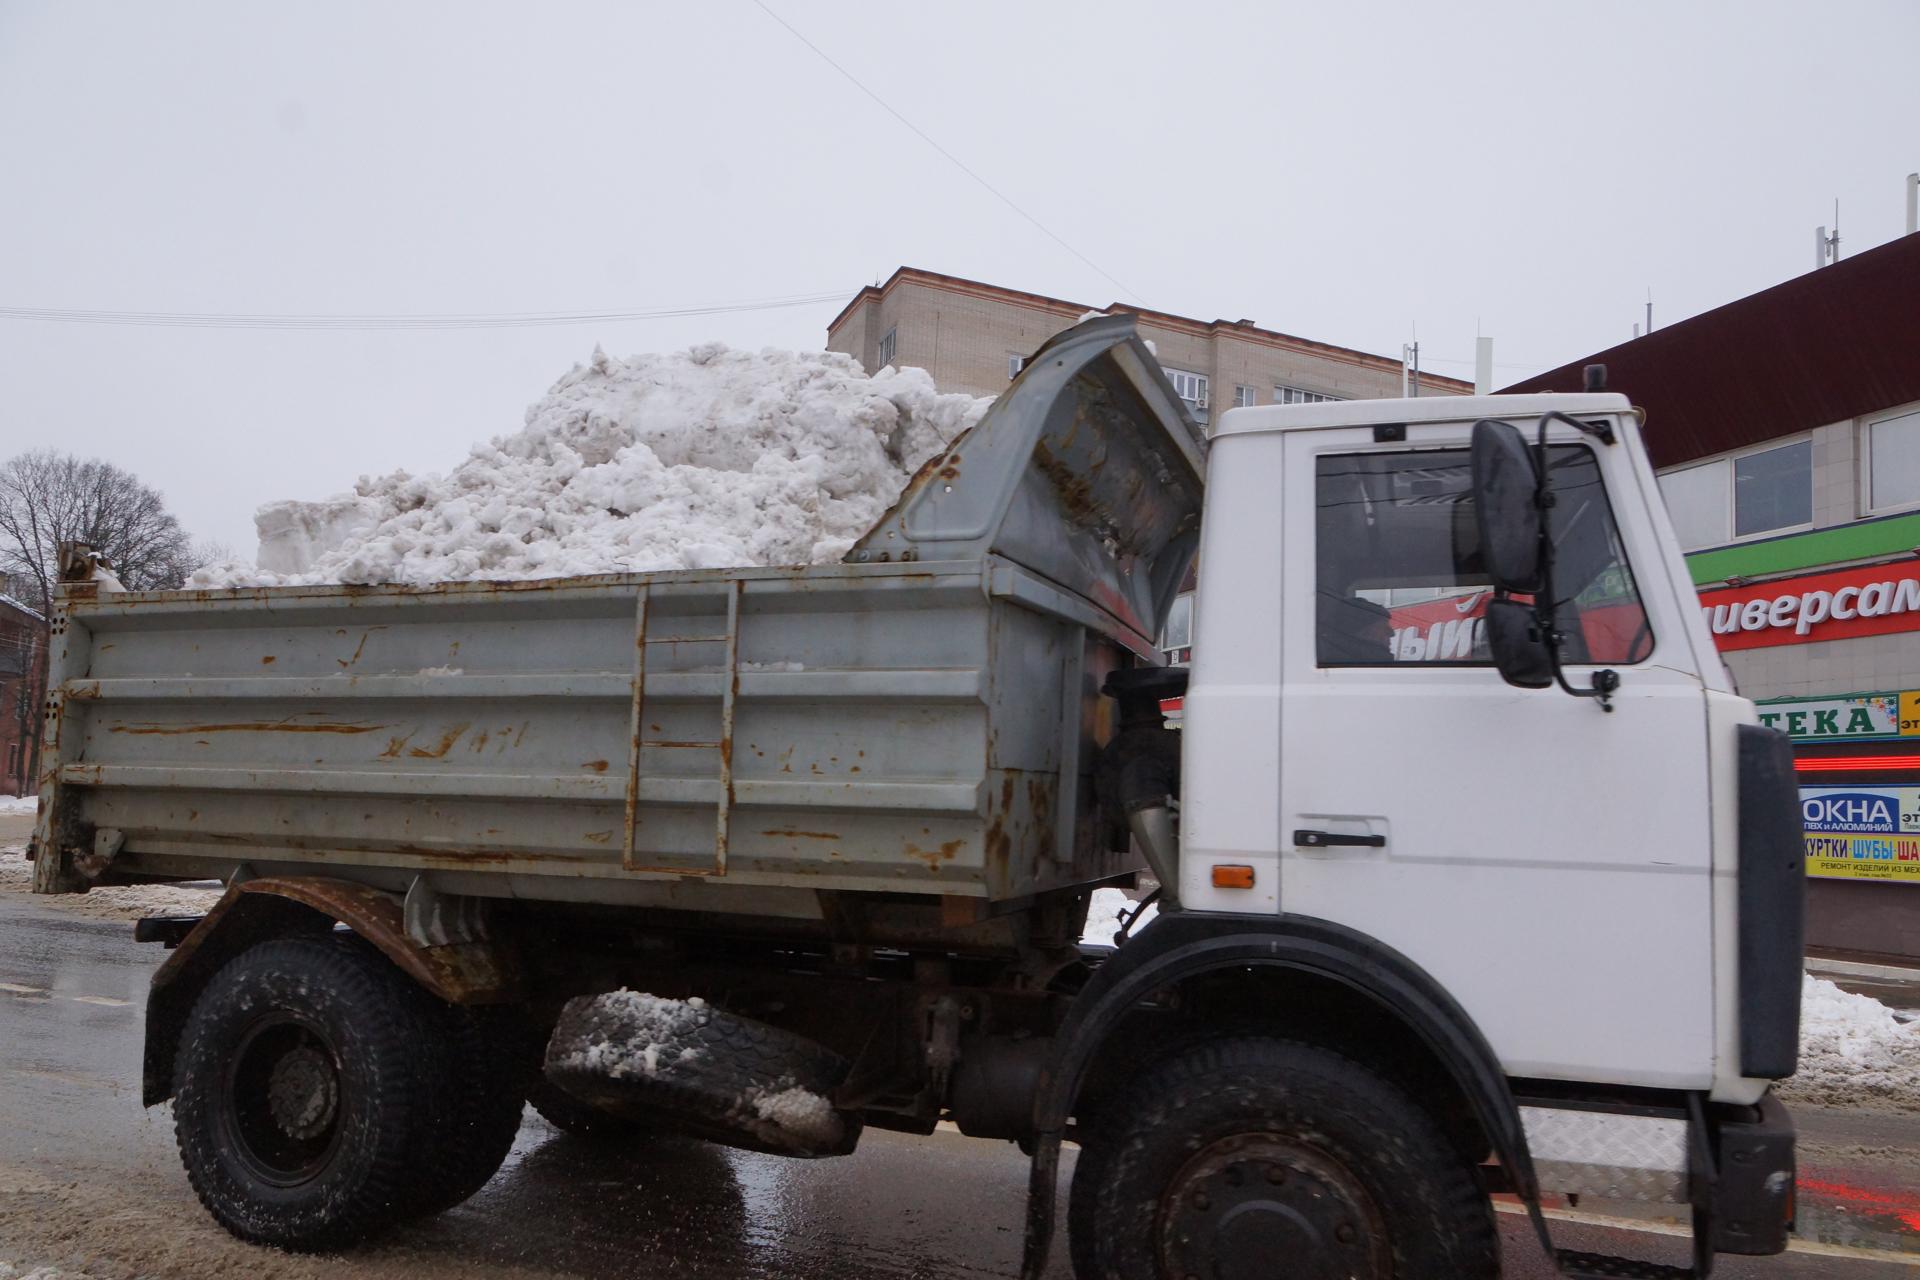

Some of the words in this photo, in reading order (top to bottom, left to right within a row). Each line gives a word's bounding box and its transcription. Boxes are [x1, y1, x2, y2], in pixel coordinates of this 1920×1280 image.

[1803, 799, 1892, 823] ОКНА
[1804, 822, 1823, 830] ПВХ
[1831, 821, 1893, 832] АЛЮМИНИЙ
[1821, 862, 1851, 870] РЕМОНТ
[1853, 863, 1889, 872] ИЗДЕЛИЙ
[1891, 865, 1901, 873] ИЗ
